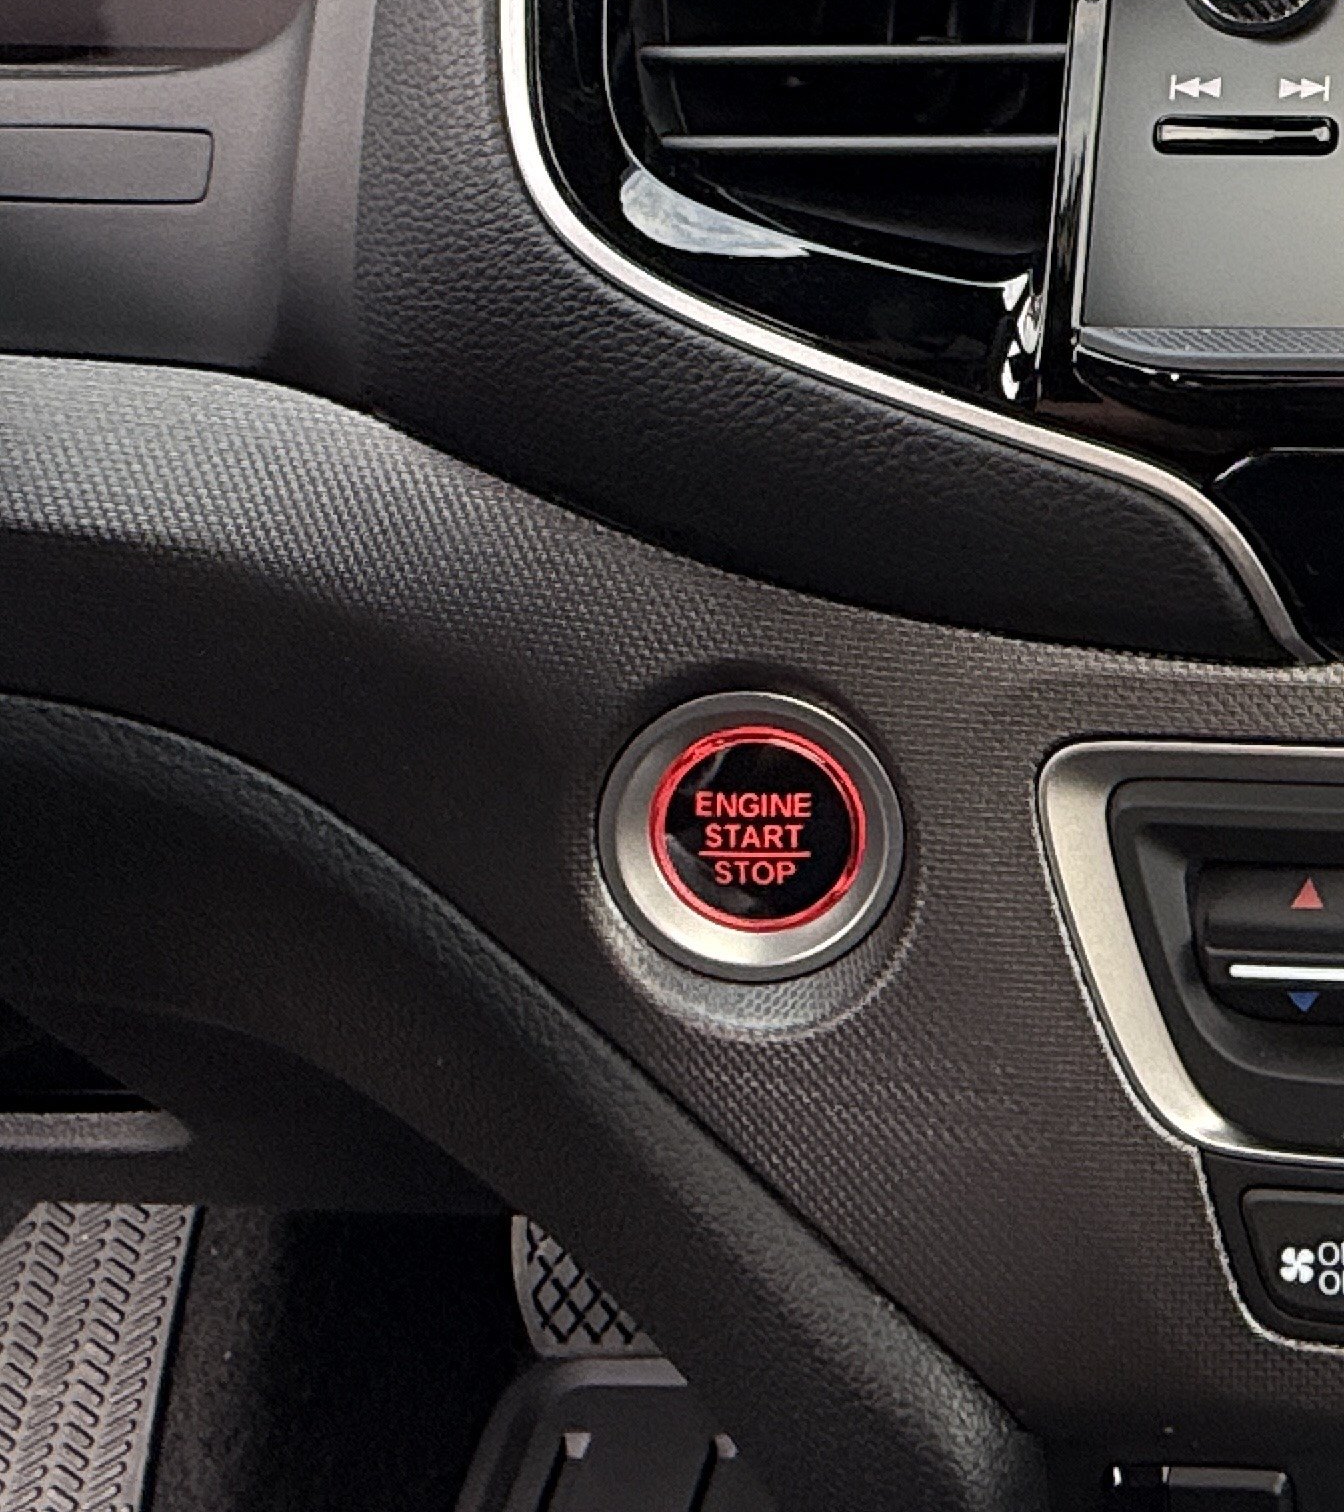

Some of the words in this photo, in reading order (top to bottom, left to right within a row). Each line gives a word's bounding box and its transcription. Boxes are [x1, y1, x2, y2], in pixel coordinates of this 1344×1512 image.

[695, 791, 812, 818] ENGINE
[704, 823, 804, 849] START
[714, 860, 797, 886] STOP
